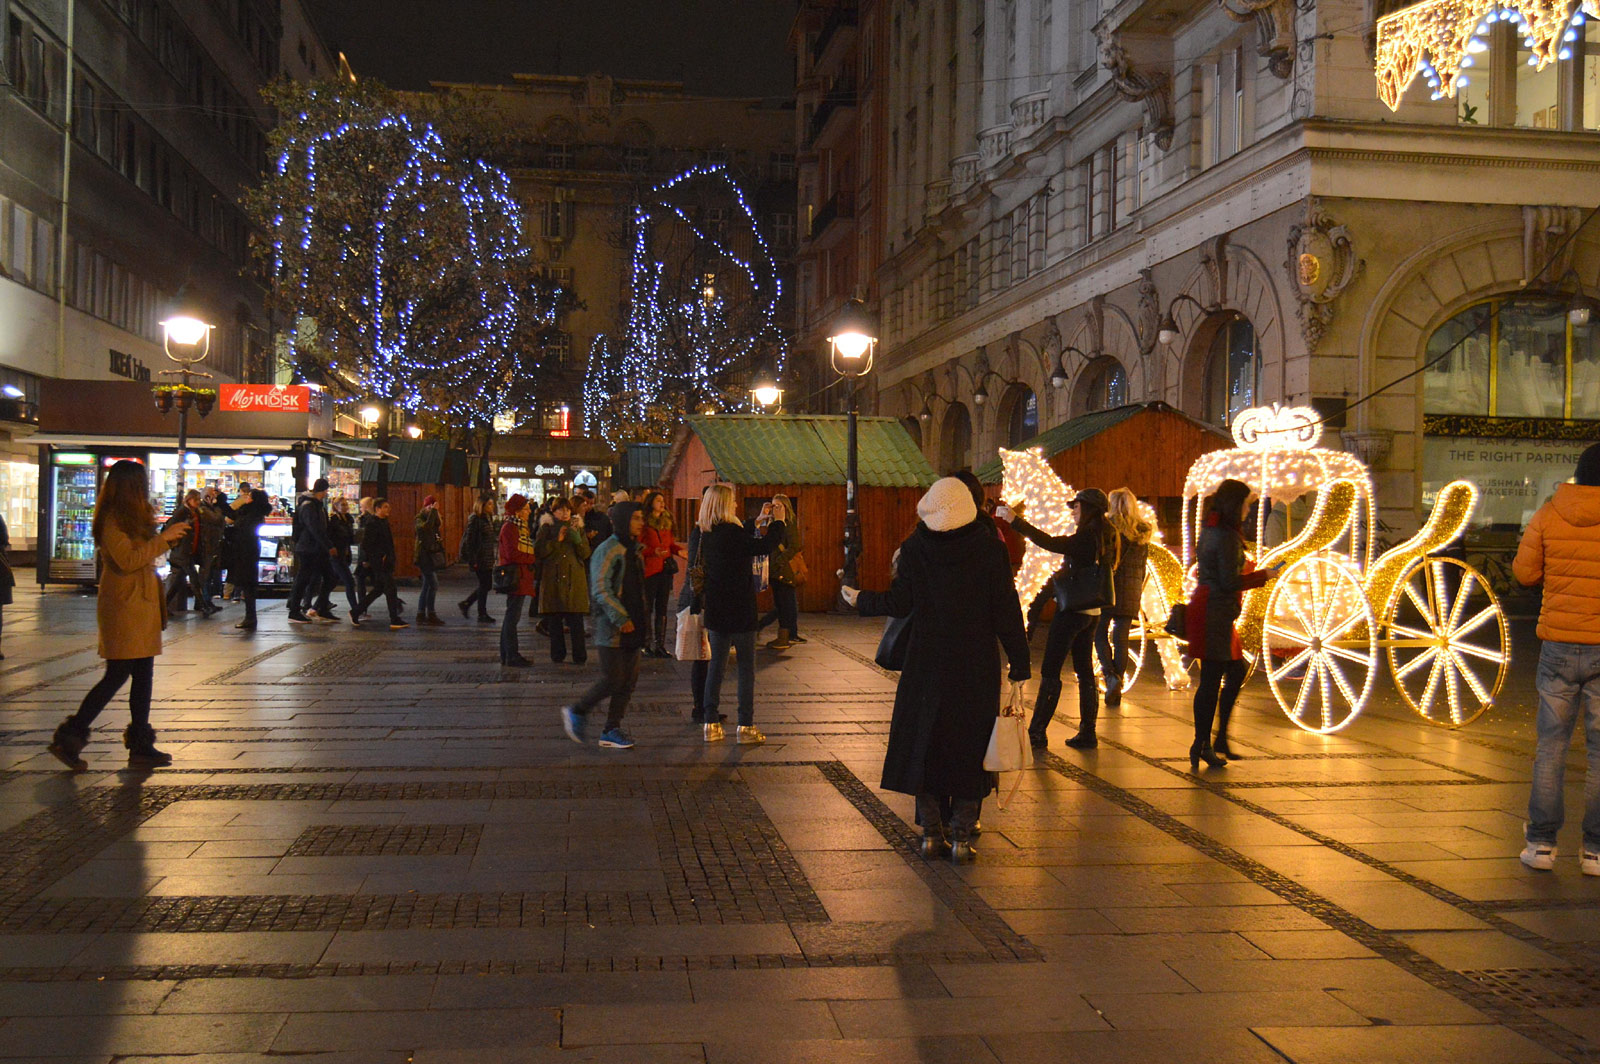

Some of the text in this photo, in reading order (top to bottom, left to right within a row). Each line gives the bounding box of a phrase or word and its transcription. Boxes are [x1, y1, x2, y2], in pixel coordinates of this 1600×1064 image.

[229, 389, 299, 408] Moj KIOSK
[1533, 440, 1590, 448] DECADE
[1449, 450, 1580, 464] THE RIGHT PARTNE
